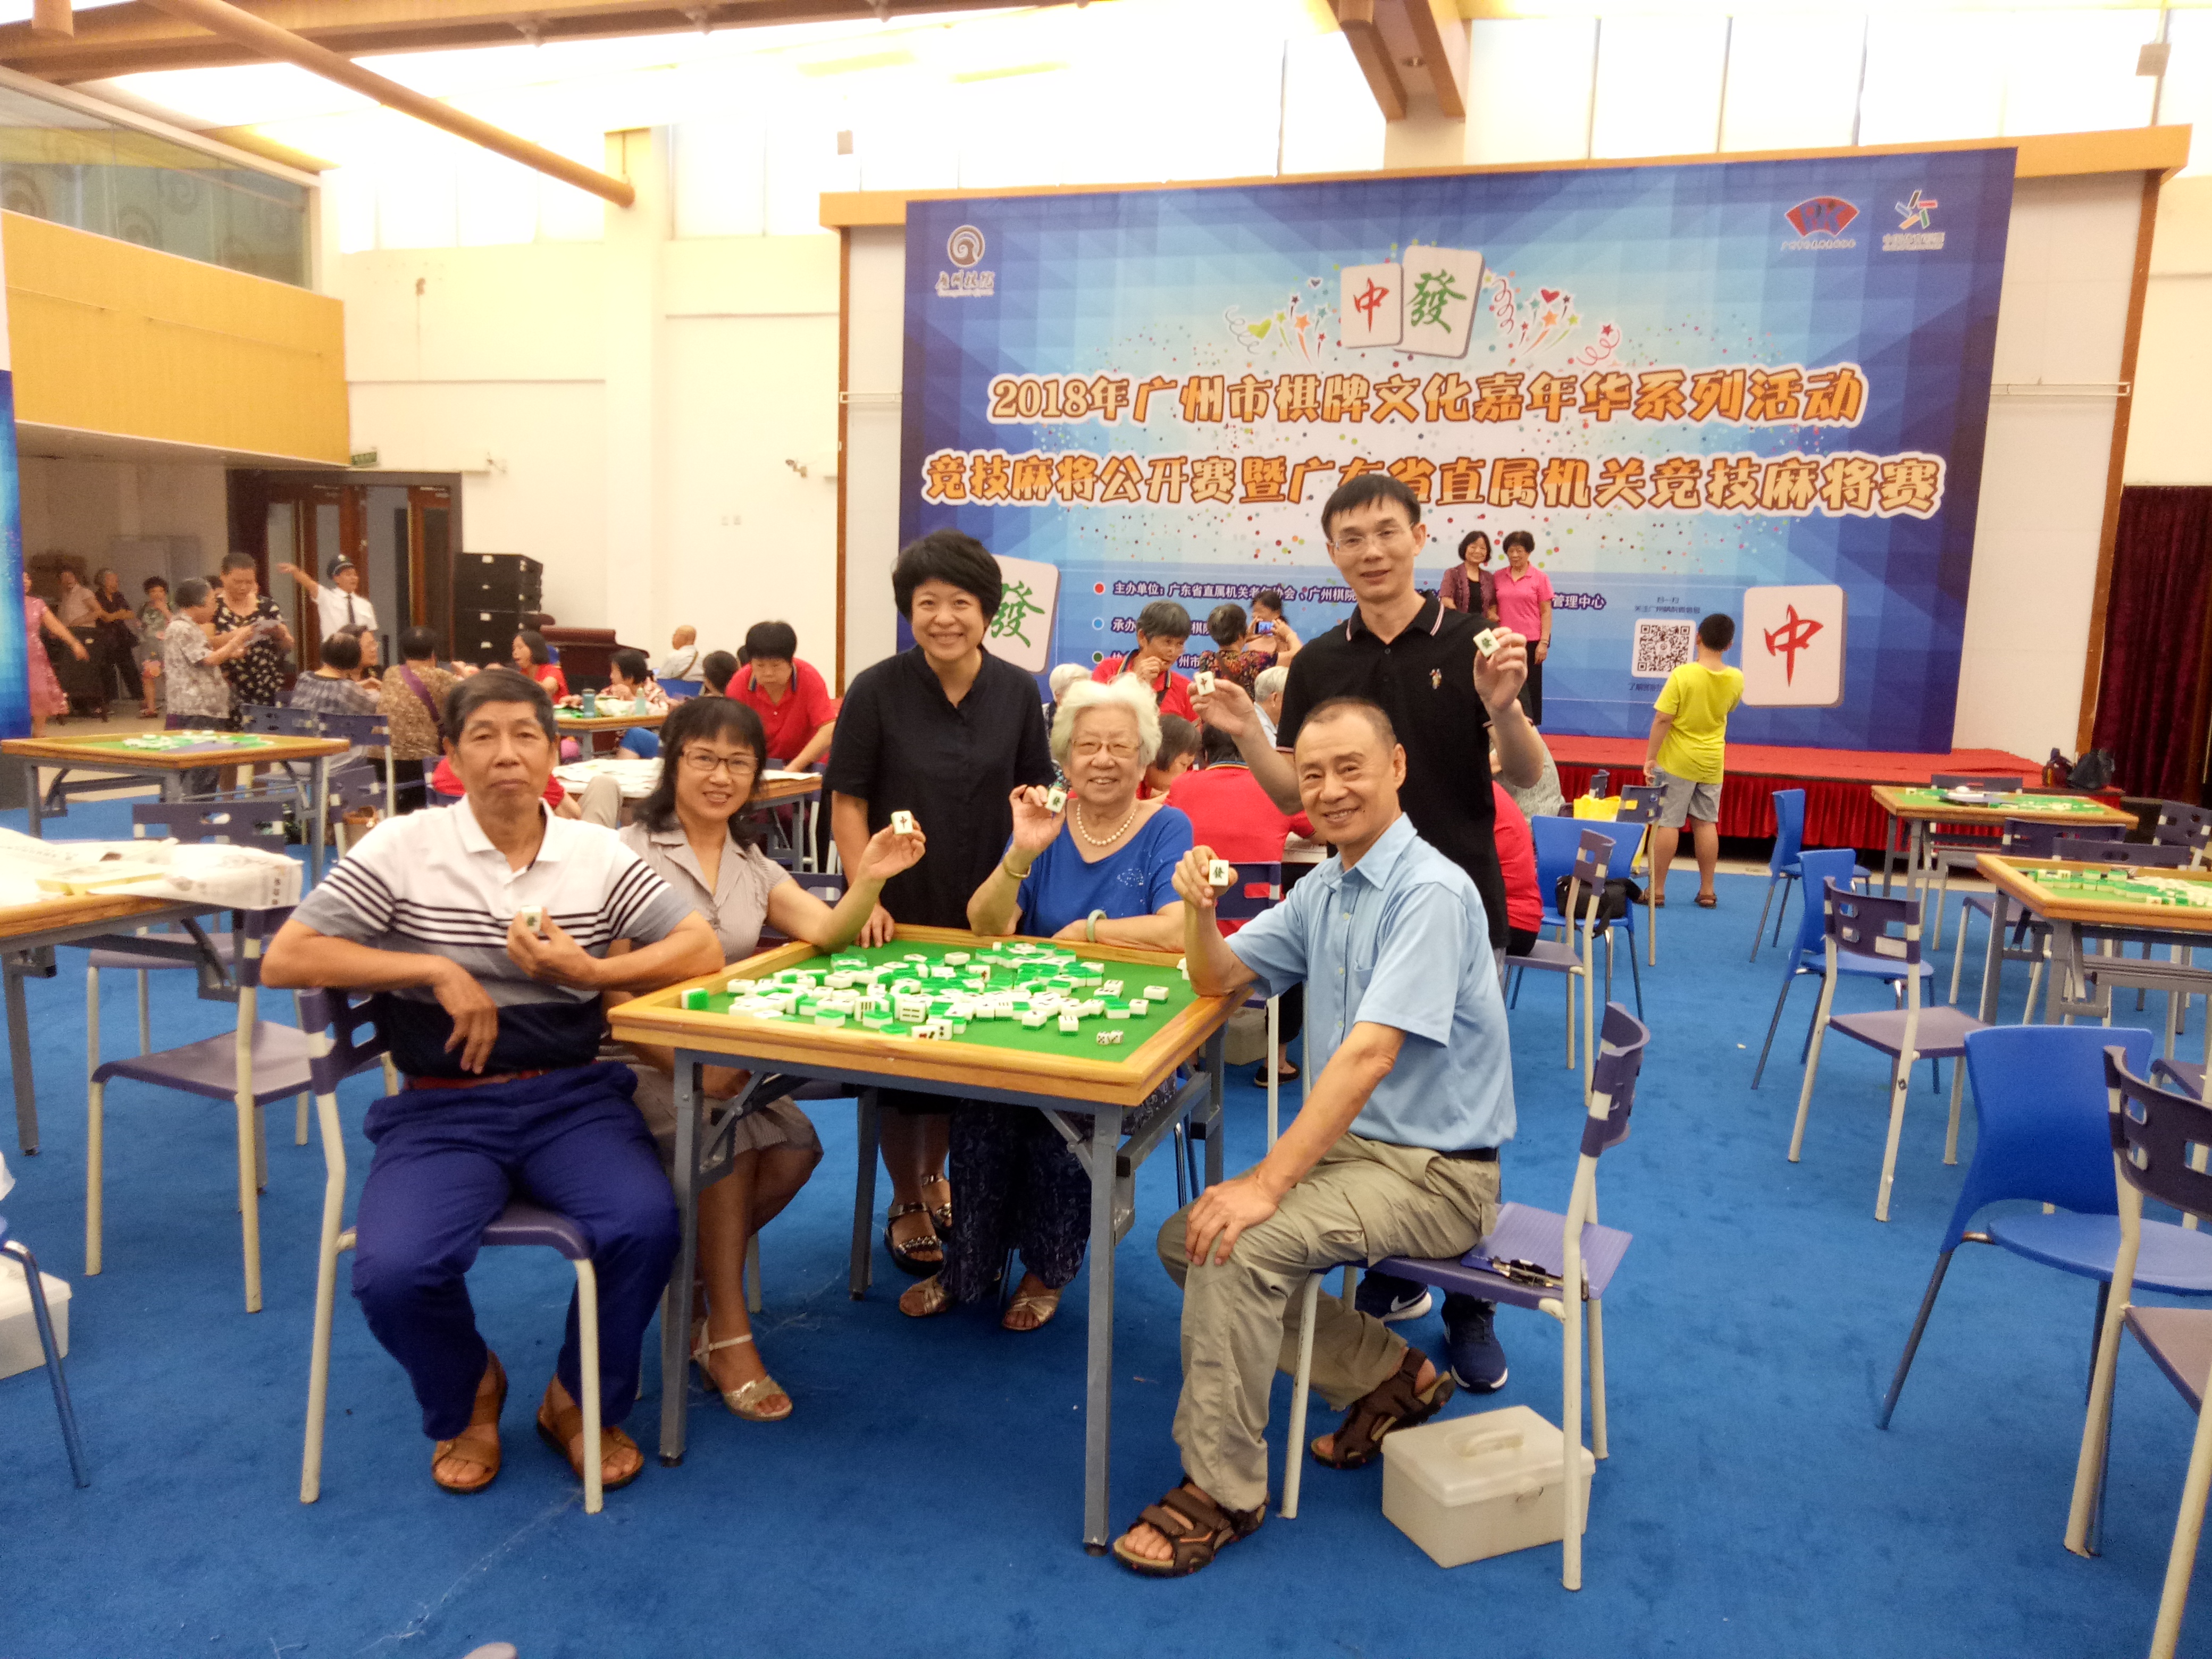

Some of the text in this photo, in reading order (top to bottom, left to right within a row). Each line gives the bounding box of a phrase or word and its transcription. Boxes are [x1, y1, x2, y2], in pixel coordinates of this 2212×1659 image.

[1353, 276, 1390, 333] 中
[1405, 268, 1468, 334] 發
[992, 365, 1863, 423] 2018年广州市棋牌文化嘉年华系列活动
[1552, 592, 1605, 609] 管理中心
[1764, 602, 1824, 688] 中
